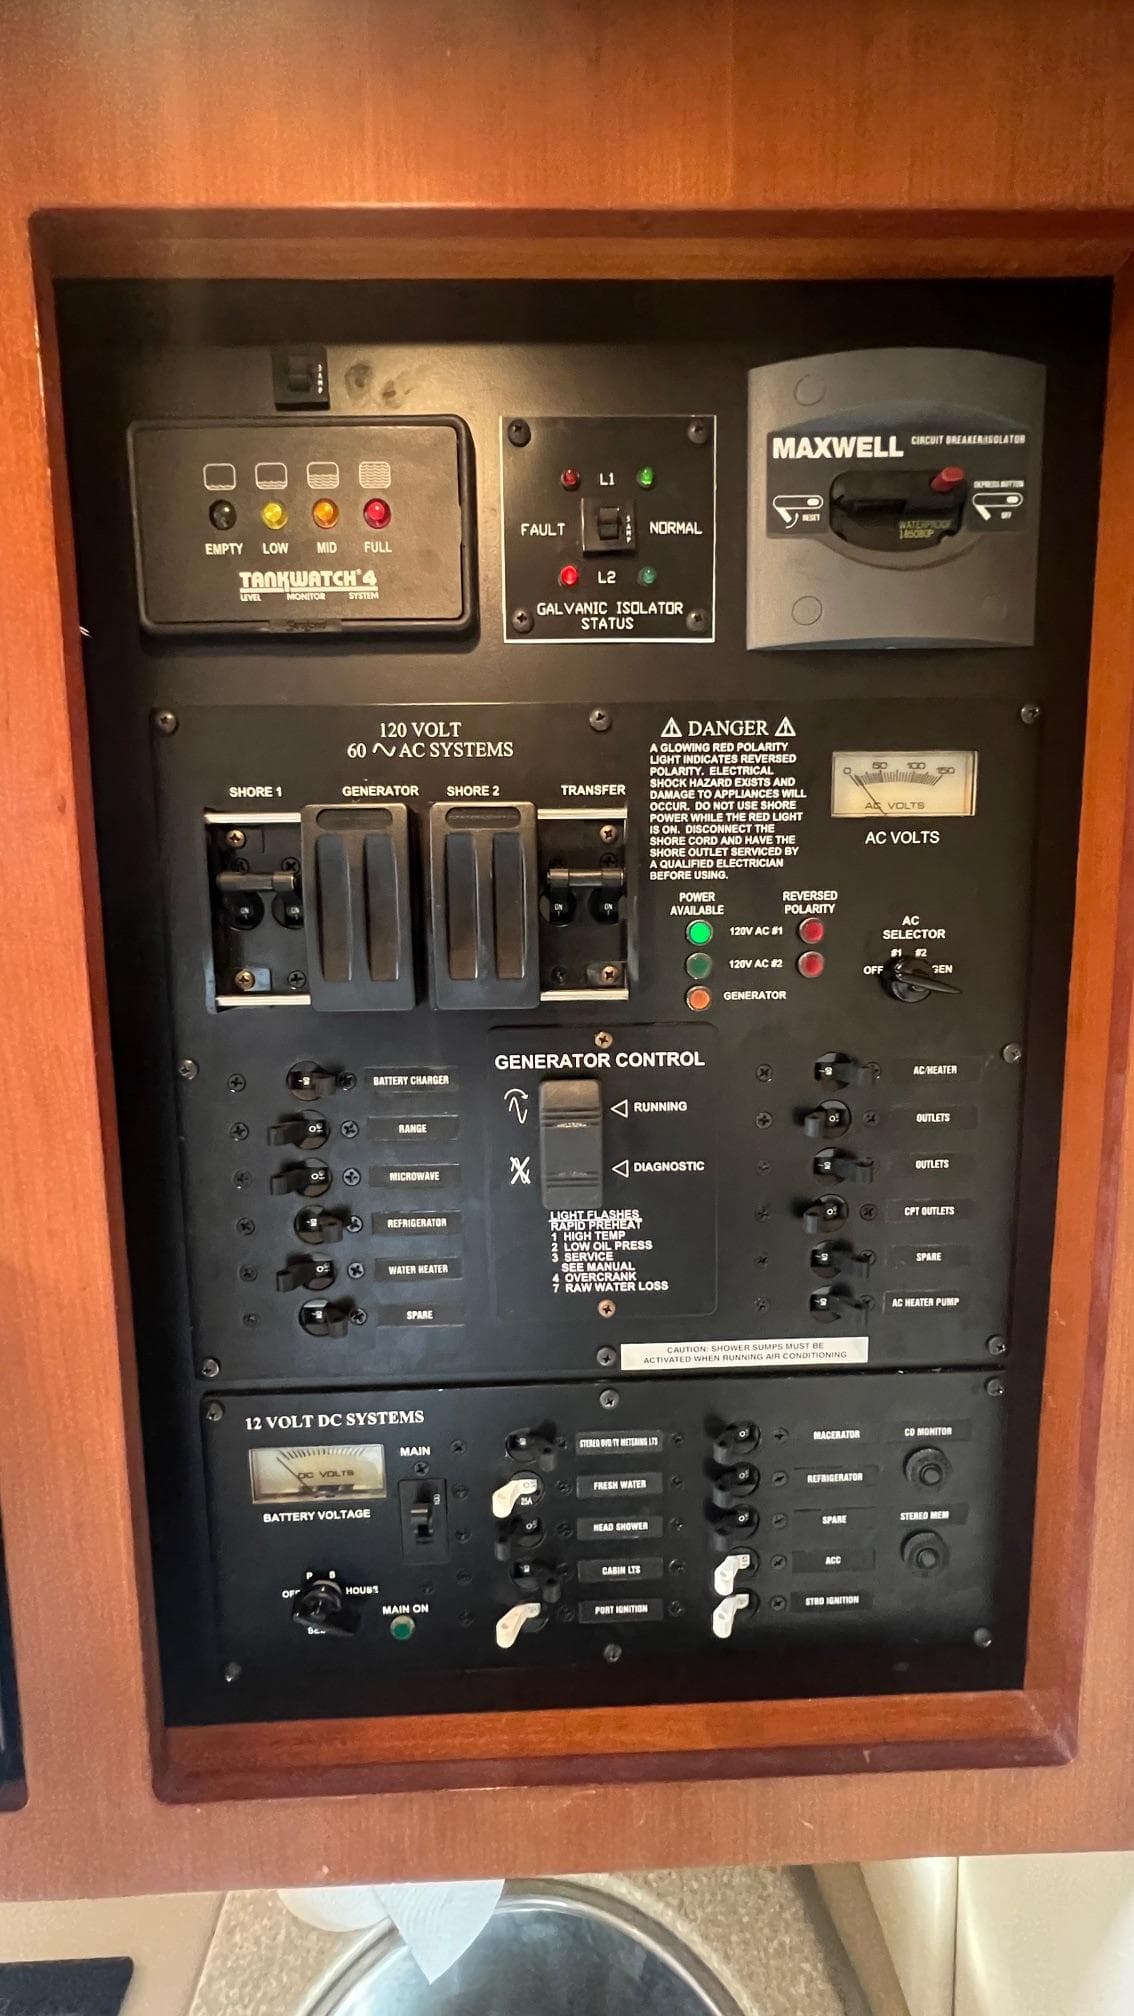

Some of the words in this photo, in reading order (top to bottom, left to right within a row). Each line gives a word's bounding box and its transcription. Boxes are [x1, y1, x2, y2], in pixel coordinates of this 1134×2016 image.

[911, 435, 944, 445] CIRCUIT
[773, 436, 904, 459] MAXWELL
[600, 473, 615, 485] L1
[521, 523, 565, 536] FAULT
[650, 522, 703, 534] NORMAL
[205, 543, 243, 555] EMPTY
[263, 543, 289, 554] LOW
[317, 542, 337, 554] MID
[364, 542, 392, 553] FULL
[363, 570, 377, 586] 4
[598, 571, 616, 584] L2
[240, 594, 261, 602] LEVEL
[349, 592, 379, 600] SYSTEM
[537, 602, 608, 616] GALVANIC
[617, 602, 683, 614] ISOLATOR
[582, 618, 634, 630] STATUS
[379, 722, 407, 738] 120
[412, 722, 462, 738] VOLT
[688, 720, 769, 737] DANGER
[347, 743, 366, 759] 60
[399, 743, 425, 758] AC
[430, 741, 513, 758] SYSTEMS
[650, 744, 658, 753] A
[660, 743, 710, 752] GLOWING
[713, 743, 734, 752] RED
[737, 742, 788, 752] POLARITY
[650, 755, 681, 764] LIGHT
[683, 754, 738, 764] INDICATES
[741, 754, 796, 763] REVERSED
[650, 767, 704, 776] POLARITY.
[709, 766, 774, 776] ELECTRICAL
[938, 767, 955, 775] 150
[650, 779, 687, 788] SHOCK
[689, 778, 732, 787] HAZARD
[734, 778, 770, 787] EXISTS
[773, 777, 795, 787] AND
[229, 786, 272, 798] SHORE
[276, 786, 282, 797] 1
[342, 785, 419, 797] GENERATOR
[446, 785, 489, 796] SHORE
[493, 785, 500, 796] 2
[561, 784, 626, 796] TRANSFER
[865, 831, 887, 844] AC
[891, 831, 940, 844] VOLTS
[650, 871, 692, 880] BEFORE
[694, 871, 728, 880] USING.
[679, 892, 715, 902] POWER
[783, 891, 838, 901] REVERSED
[671, 905, 724, 916] AVAILABLE
[784, 904, 835, 914] POLARITY
[902, 916, 919, 926] AC
[730, 927, 753, 936] 120V
[755, 926, 770, 936] AC
[771, 926, 783, 935] #1
[883, 929, 946, 940] SELECTOR
[864, 966, 884, 975] OFF
[723, 991, 786, 1000] GENERATOR
[495, 1053, 611, 1069] GENERATOR
[615, 1051, 705, 1067] CONTROL
[373, 1076, 408, 1086] BATTERY
[411, 1075, 449, 1085] CHARGER
[634, 1102, 687, 1112] RUNNING
[916, 1113, 950, 1122] OUTLETS
[399, 1124, 427, 1133] RANGE
[634, 1161, 705, 1172] DIAGNOSTIC
[916, 1160, 949, 1169] OUTLETS
[389, 1172, 440, 1181] MICROWAVE
[550, 1211, 584, 1220] LIGHT
[587, 1210, 639, 1220] FLASHES
[905, 1207, 919, 1216] CPT
[921, 1206, 954, 1215] OUTLETS
[387, 1218, 447, 1228] REFRIGERATOR
[550, 1221, 586, 1231] RAPID
[589, 1221, 642, 1230] PREHEAT
[552, 1232, 557, 1241] 1
[564, 1231, 591, 1241] HIGH
[595, 1231, 626, 1240] TEMP
[552, 1243, 558, 1252] 2
[564, 1242, 590, 1251] LOW
[593, 1241, 612, 1251] OIL
[615, 1240, 653, 1250] PRESS
[552, 1253, 558, 1262] 3
[564, 1252, 613, 1262] SERVICE
[916, 1253, 941, 1261] SPARE
[389, 1265, 416, 1274] WATER
[418, 1264, 448, 1273] HEATER
[561, 1263, 584, 1272] SEE
[587, 1262, 635, 1272] MANUAL
[552, 1273, 559, 1282] 4
[565, 1272, 637, 1282] OVERCRANK
[553, 1284, 559, 1293] 7
[565, 1283, 593, 1292] RAW
[595, 1282, 636, 1292] WATER
[638, 1281, 669, 1291] LOSS
[892, 1299, 903, 1307] AC
[905, 1298, 934, 1307] HEATER
[936, 1297, 959, 1306] PUMP
[407, 1310, 433, 1320] SPARE
[711, 1344, 750, 1352] SHOWER
[753, 1343, 783, 1351] SUMPS
[644, 1356, 691, 1364] ACTIVATED
[694, 1354, 720, 1362] WHEN
[723, 1354, 763, 1362] RUNNING
[783, 1351, 847, 1360] CONDITIONING
[246, 1417, 262, 1430] 12
[266, 1415, 313, 1429] VOLT
[318, 1413, 342, 1427] DC
[346, 1410, 424, 1426] SYSTEMS
[814, 1430, 860, 1440] MACERATOR
[917, 1427, 952, 1436] MONITOR
[400, 1447, 431, 1456] MAIN
[320, 1470, 354, 1478] VOLTS
[807, 1473, 863, 1483] REFRIGERATOR
[594, 1481, 619, 1490] FRESH
[620, 1480, 646, 1489] WATER
[263, 1512, 315, 1523] BATTERY
[318, 1509, 371, 1520] VOLTAGE
[822, 1515, 847, 1524] SPARE
[900, 1511, 928, 1520] STEREO
[930, 1511, 949, 1520] MEM
[594, 1523, 614, 1532] HEAD
[616, 1522, 648, 1531] SHOWER
[825, 1556, 841, 1565] ACC
[602, 1566, 626, 1575] CABIN
[628, 1566, 641, 1574] LTS
[306, 1572, 313, 1580] P
[826, 1596, 859, 1605] IGNITION
[383, 1606, 409, 1615] MAIN
[413, 1605, 429, 1613] ON
[595, 1606, 614, 1614] PORT
[616, 1605, 648, 1613] IGNITION
